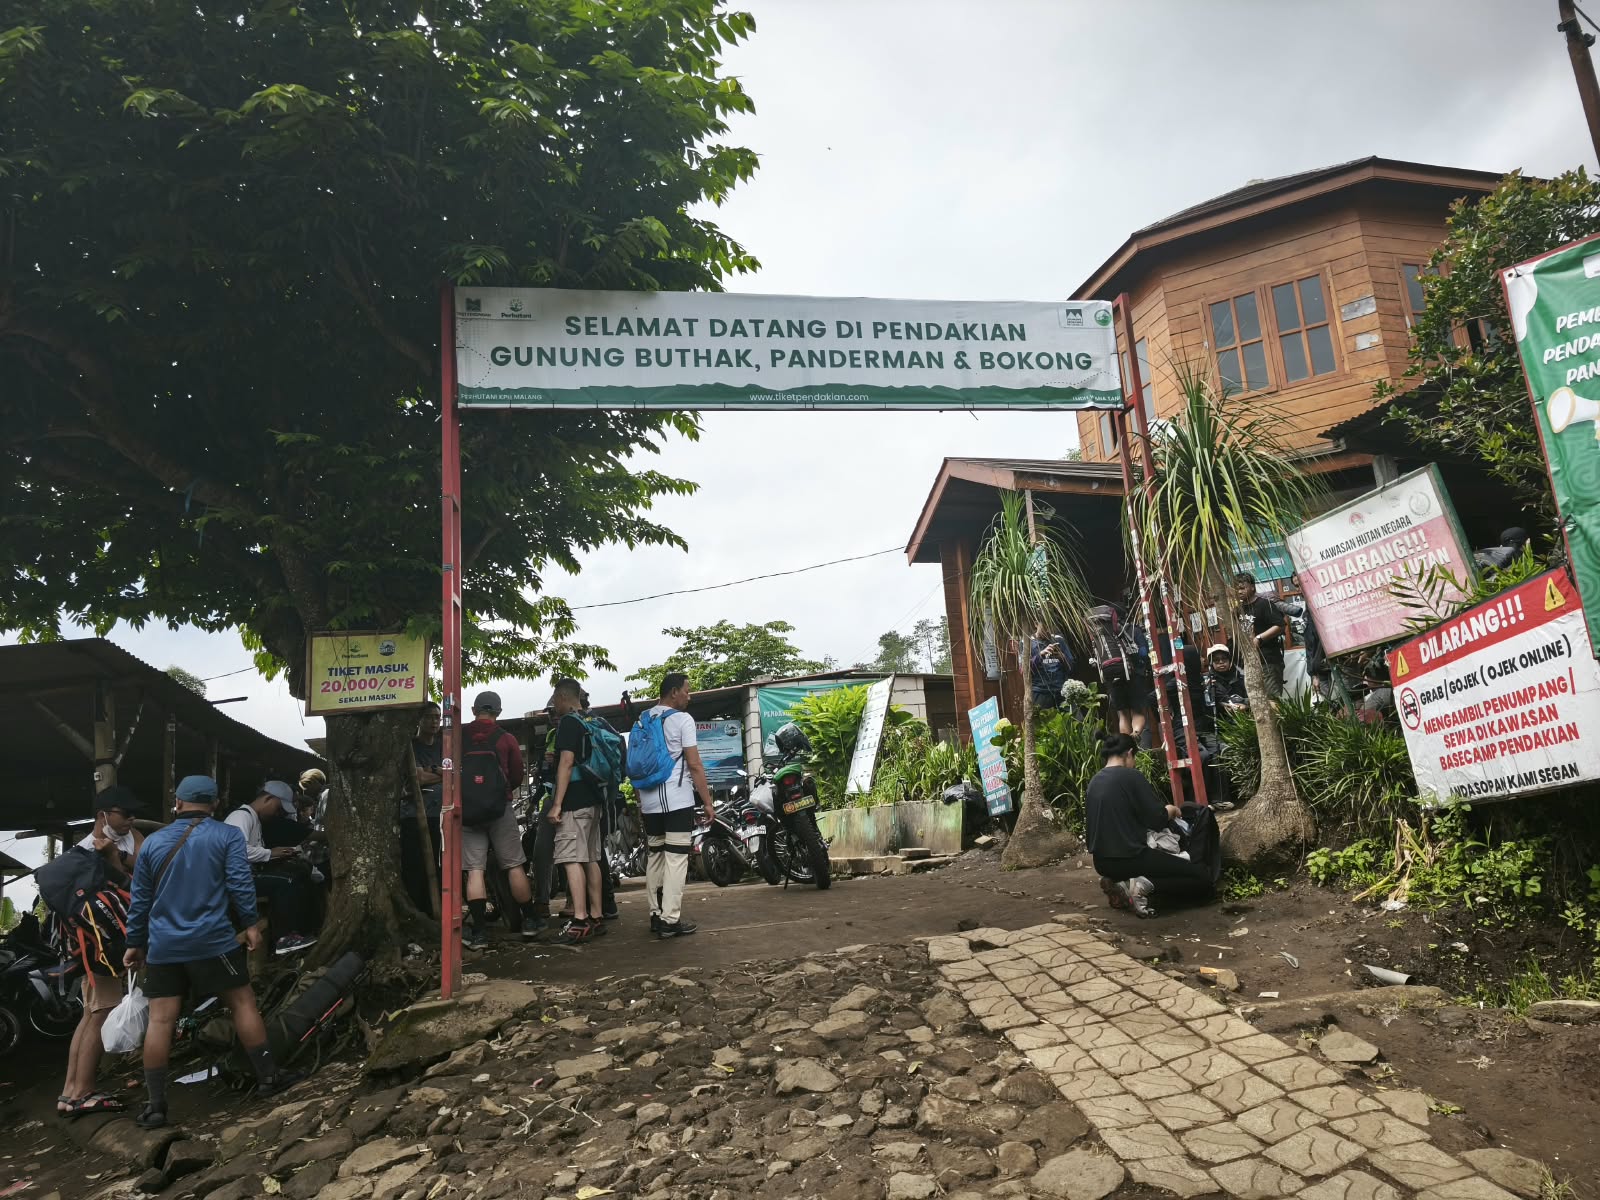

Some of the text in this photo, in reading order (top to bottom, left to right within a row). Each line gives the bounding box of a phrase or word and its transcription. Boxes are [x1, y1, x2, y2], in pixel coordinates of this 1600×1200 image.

[565, 316, 1026, 341] SELAMAT DATANG DI PENDAKIAN
[490, 346, 1092, 372] GUNUNG BUTHAK, PANDERMAN & BOKONG
[750, 393, 869, 402] www.tiketpendakian.com
[1319, 514, 1412, 561] KAWASAN HUTAN NEGARA
[1316, 528, 1430, 589] DILARANG!!!
[1312, 568, 1394, 609] MEMBAKAR
[1399, 547, 1451, 579] HUTAN
[1418, 594, 1525, 665] DILARANG!!!
[320, 676, 416, 693] 20.000/org
[328, 663, 408, 676] TIKET MASUK
[338, 694, 396, 704] SEKALI MASUK
[1423, 704, 1484, 736] MENGAMBIL
[1484, 675, 1568, 717] PENUMPANG
[1443, 702, 1560, 750] SEWA DI KAWASAN
[1439, 722, 1580, 771] BASECAMP PENDAKIAN
[1507, 770, 1538, 790] KAMI
[1540, 762, 1580, 784] SEGAN
